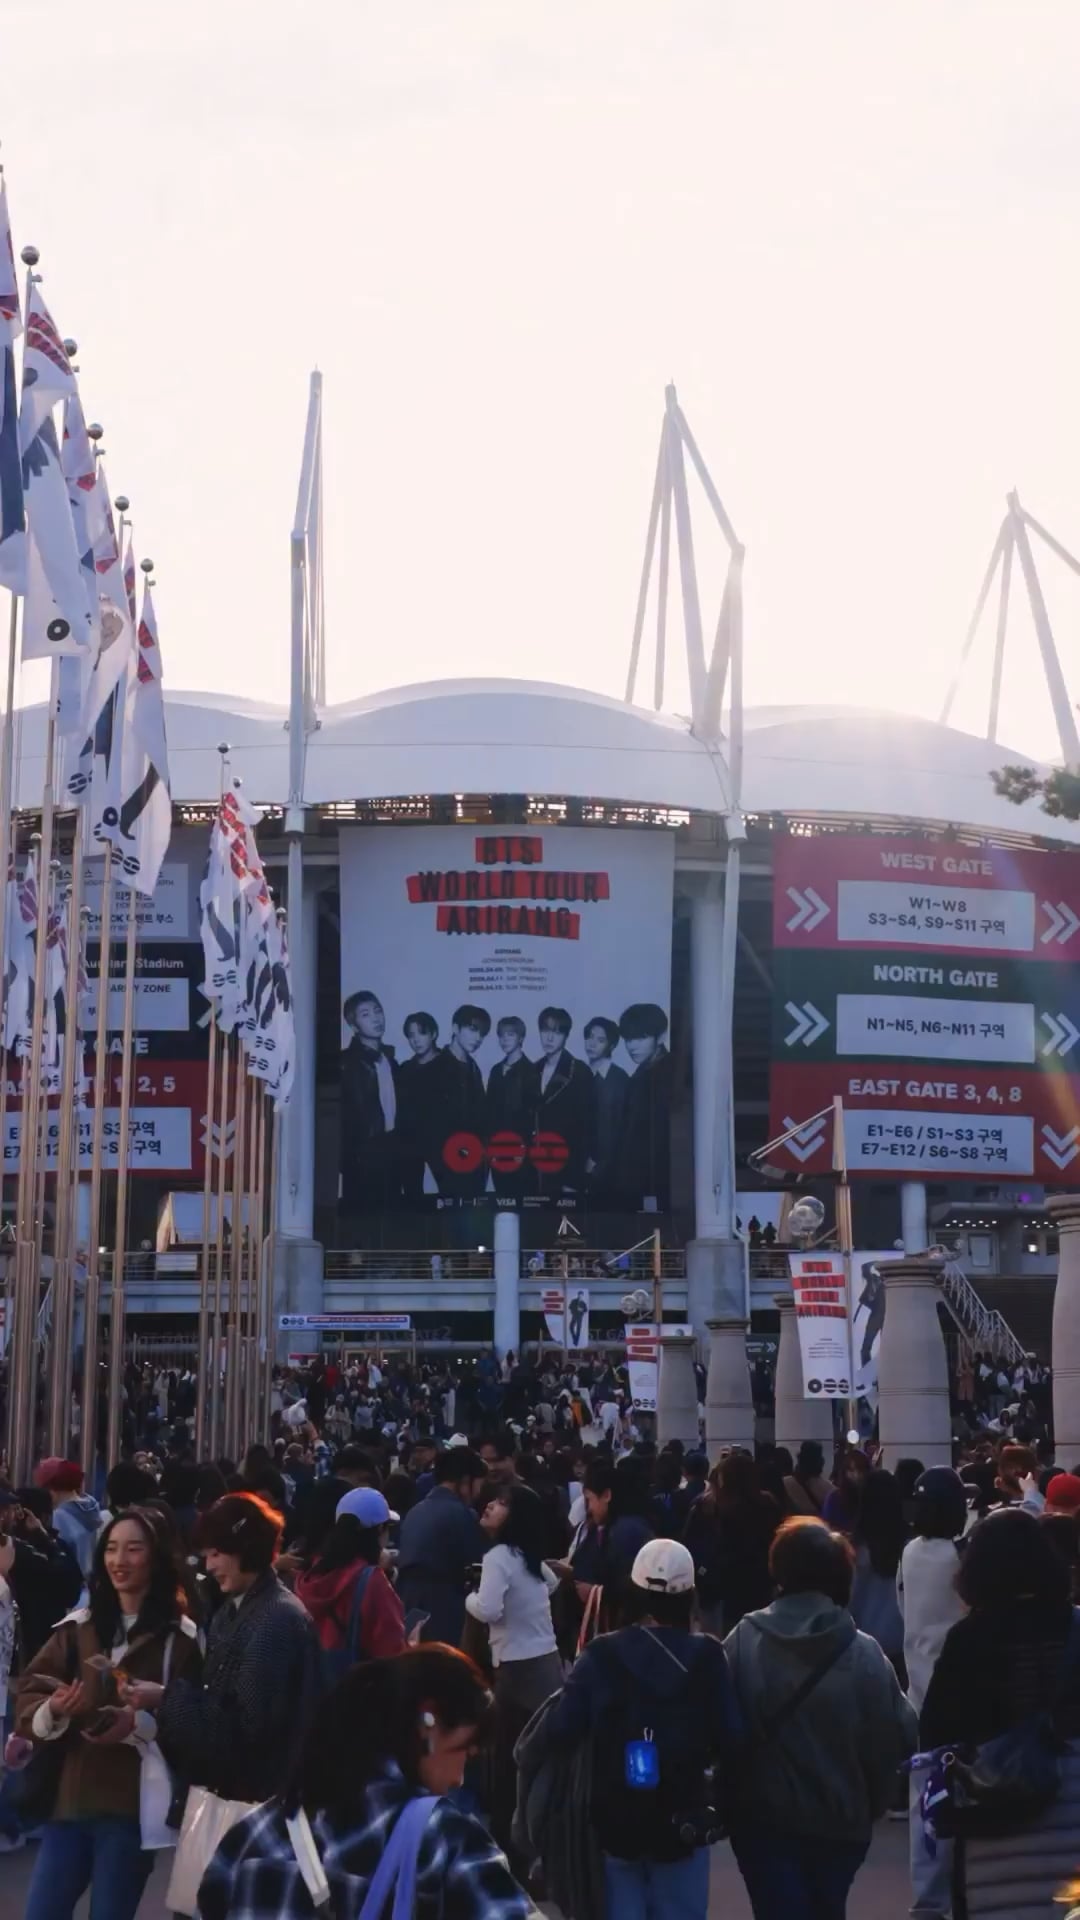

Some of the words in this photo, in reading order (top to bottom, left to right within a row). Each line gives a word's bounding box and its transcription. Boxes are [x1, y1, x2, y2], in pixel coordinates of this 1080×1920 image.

[482, 836, 534, 865] BTS
[880, 852, 936, 872] WEST
[942, 857, 993, 876] GATE
[418, 870, 515, 902] WORLD
[528, 871, 599, 903] TOUR
[909, 896, 967, 913] W1~W8
[87, 913, 124, 924] CHCK
[446, 905, 571, 936] ARIRANG
[868, 912, 921, 931] S3~S4,
[925, 916, 977, 932] S9~S11
[980, 919, 1006, 935] 구역
[135, 957, 184, 969] Stadium
[873, 965, 943, 985] NORTH
[949, 970, 999, 988] GATE
[143, 984, 171, 993] ZONE
[867, 1017, 918, 1035] N1~N5,
[921, 1020, 976, 1036] N6~N11
[980, 1023, 1005, 1038] 구역
[138, 1076, 157, 1096] 2,
[163, 1076, 176, 1093] 5
[849, 1079, 900, 1096] EAST
[905, 1080, 958, 1099] GATE
[964, 1084, 981, 1104] 3,
[986, 1086, 1003, 1105] 4,
[1009, 1087, 1022, 1102] 8
[867, 1124, 914, 1139] E1~E6
[916, 1126, 924, 1141] /
[927, 1127, 974, 1141] S1~S3
[977, 1128, 1003, 1144] 구역
[134, 1139, 162, 1155] 구역
[861, 1143, 916, 1157] E7~E12
[919, 1144, 926, 1158] /
[929, 1145, 979, 1160] S6~S8
[982, 1147, 1008, 1162] 구역
